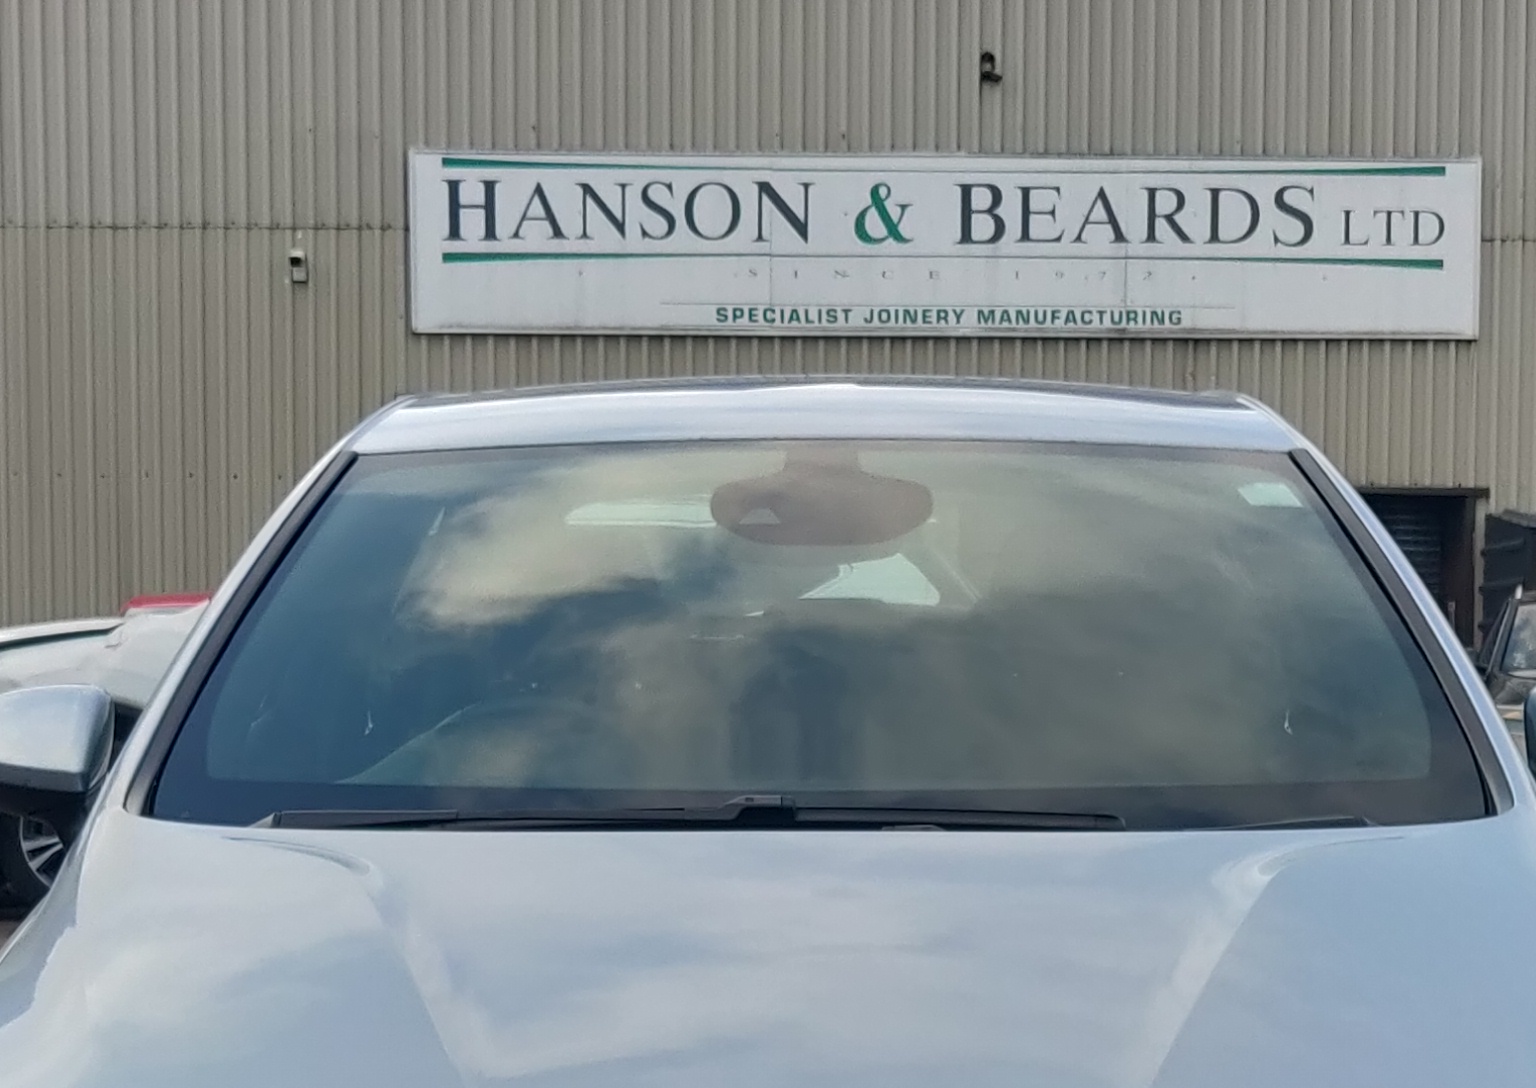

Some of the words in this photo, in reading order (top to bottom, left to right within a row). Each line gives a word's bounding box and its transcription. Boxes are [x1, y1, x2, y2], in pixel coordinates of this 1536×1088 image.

[443, 179, 812, 244] HANSON
[854, 182, 913, 245] &
[956, 183, 1315, 248] BEARDS
[1342, 209, 1446, 246] LTD
[715, 307, 853, 325] SPECIALIST
[863, 308, 965, 326] JOINERY
[977, 309, 1183, 327] MANUFACTURING
